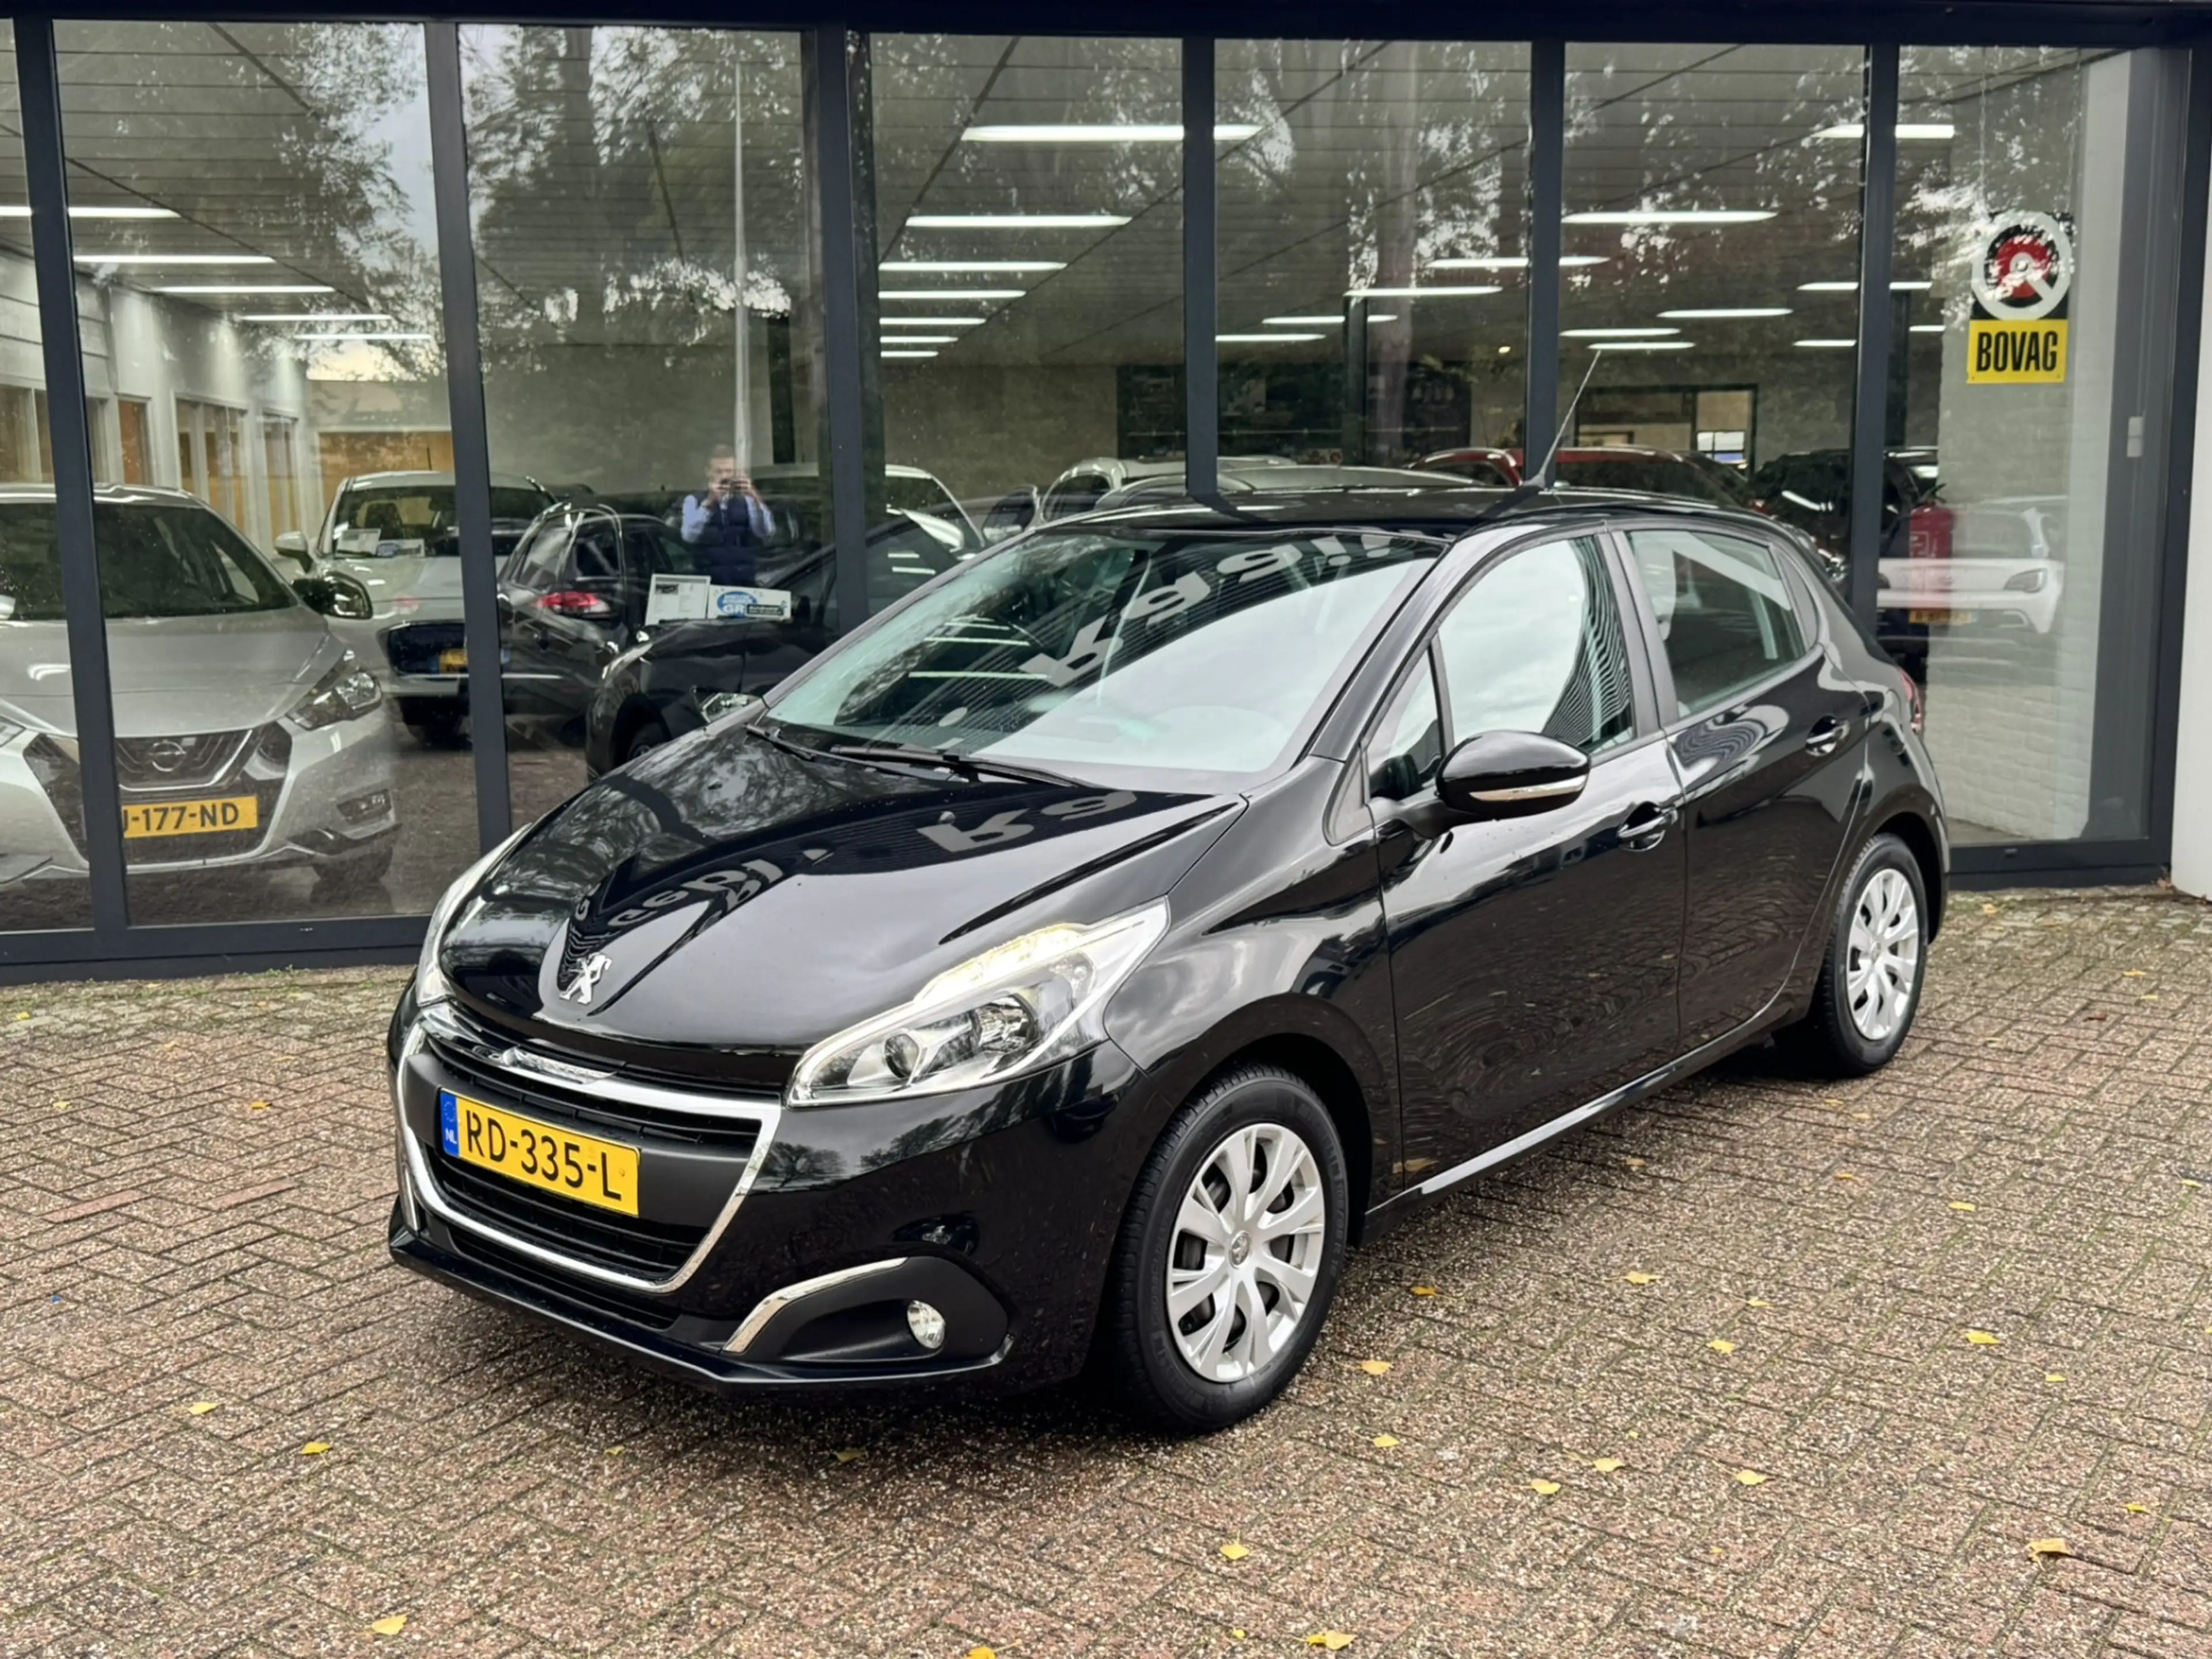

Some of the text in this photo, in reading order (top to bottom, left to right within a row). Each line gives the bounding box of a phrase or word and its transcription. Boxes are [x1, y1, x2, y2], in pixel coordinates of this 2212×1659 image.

[1976, 331, 2059, 373] BOVAG
[445, 1127, 458, 1145] NL
[465, 1109, 622, 1201] RD-335-L
